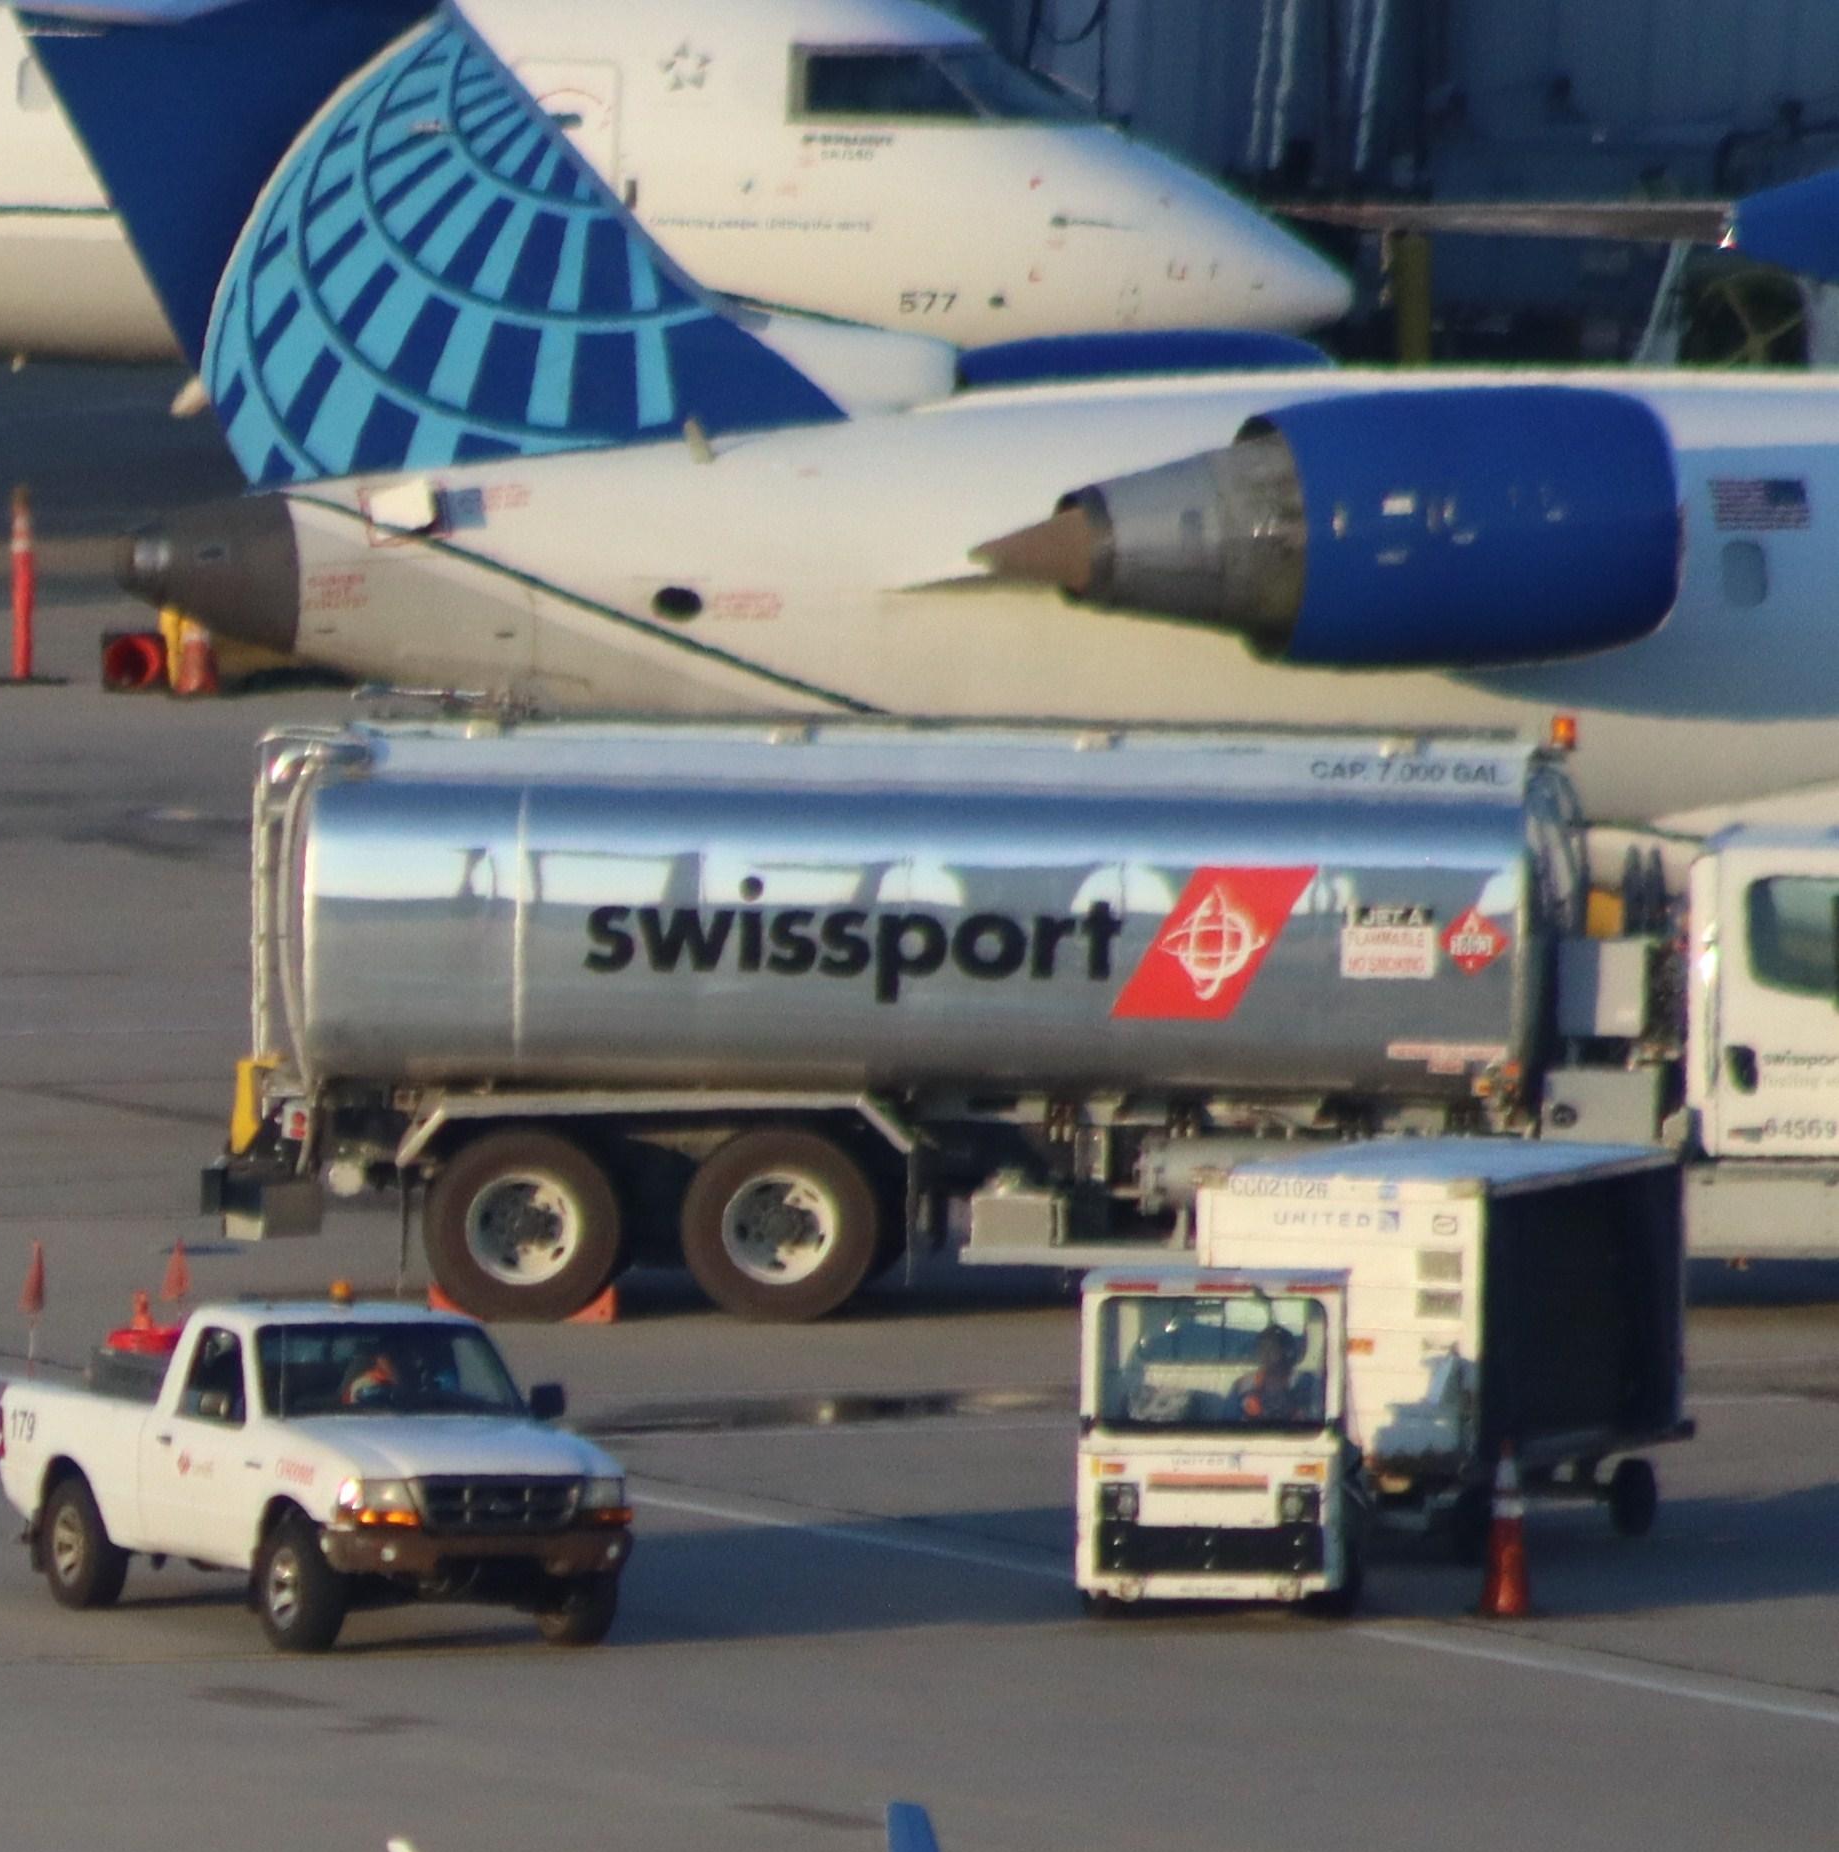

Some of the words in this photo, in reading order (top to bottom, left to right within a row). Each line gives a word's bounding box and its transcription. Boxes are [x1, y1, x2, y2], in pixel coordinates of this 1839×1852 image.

[898, 291, 958, 314] 577
[1407, 906, 1425, 927] A
[583, 875, 1124, 1003] swissport
[1762, 1050, 1839, 1071] swisspor
[1273, 1211, 1371, 1228] UNITED
[11, 1408, 36, 1442] 179
